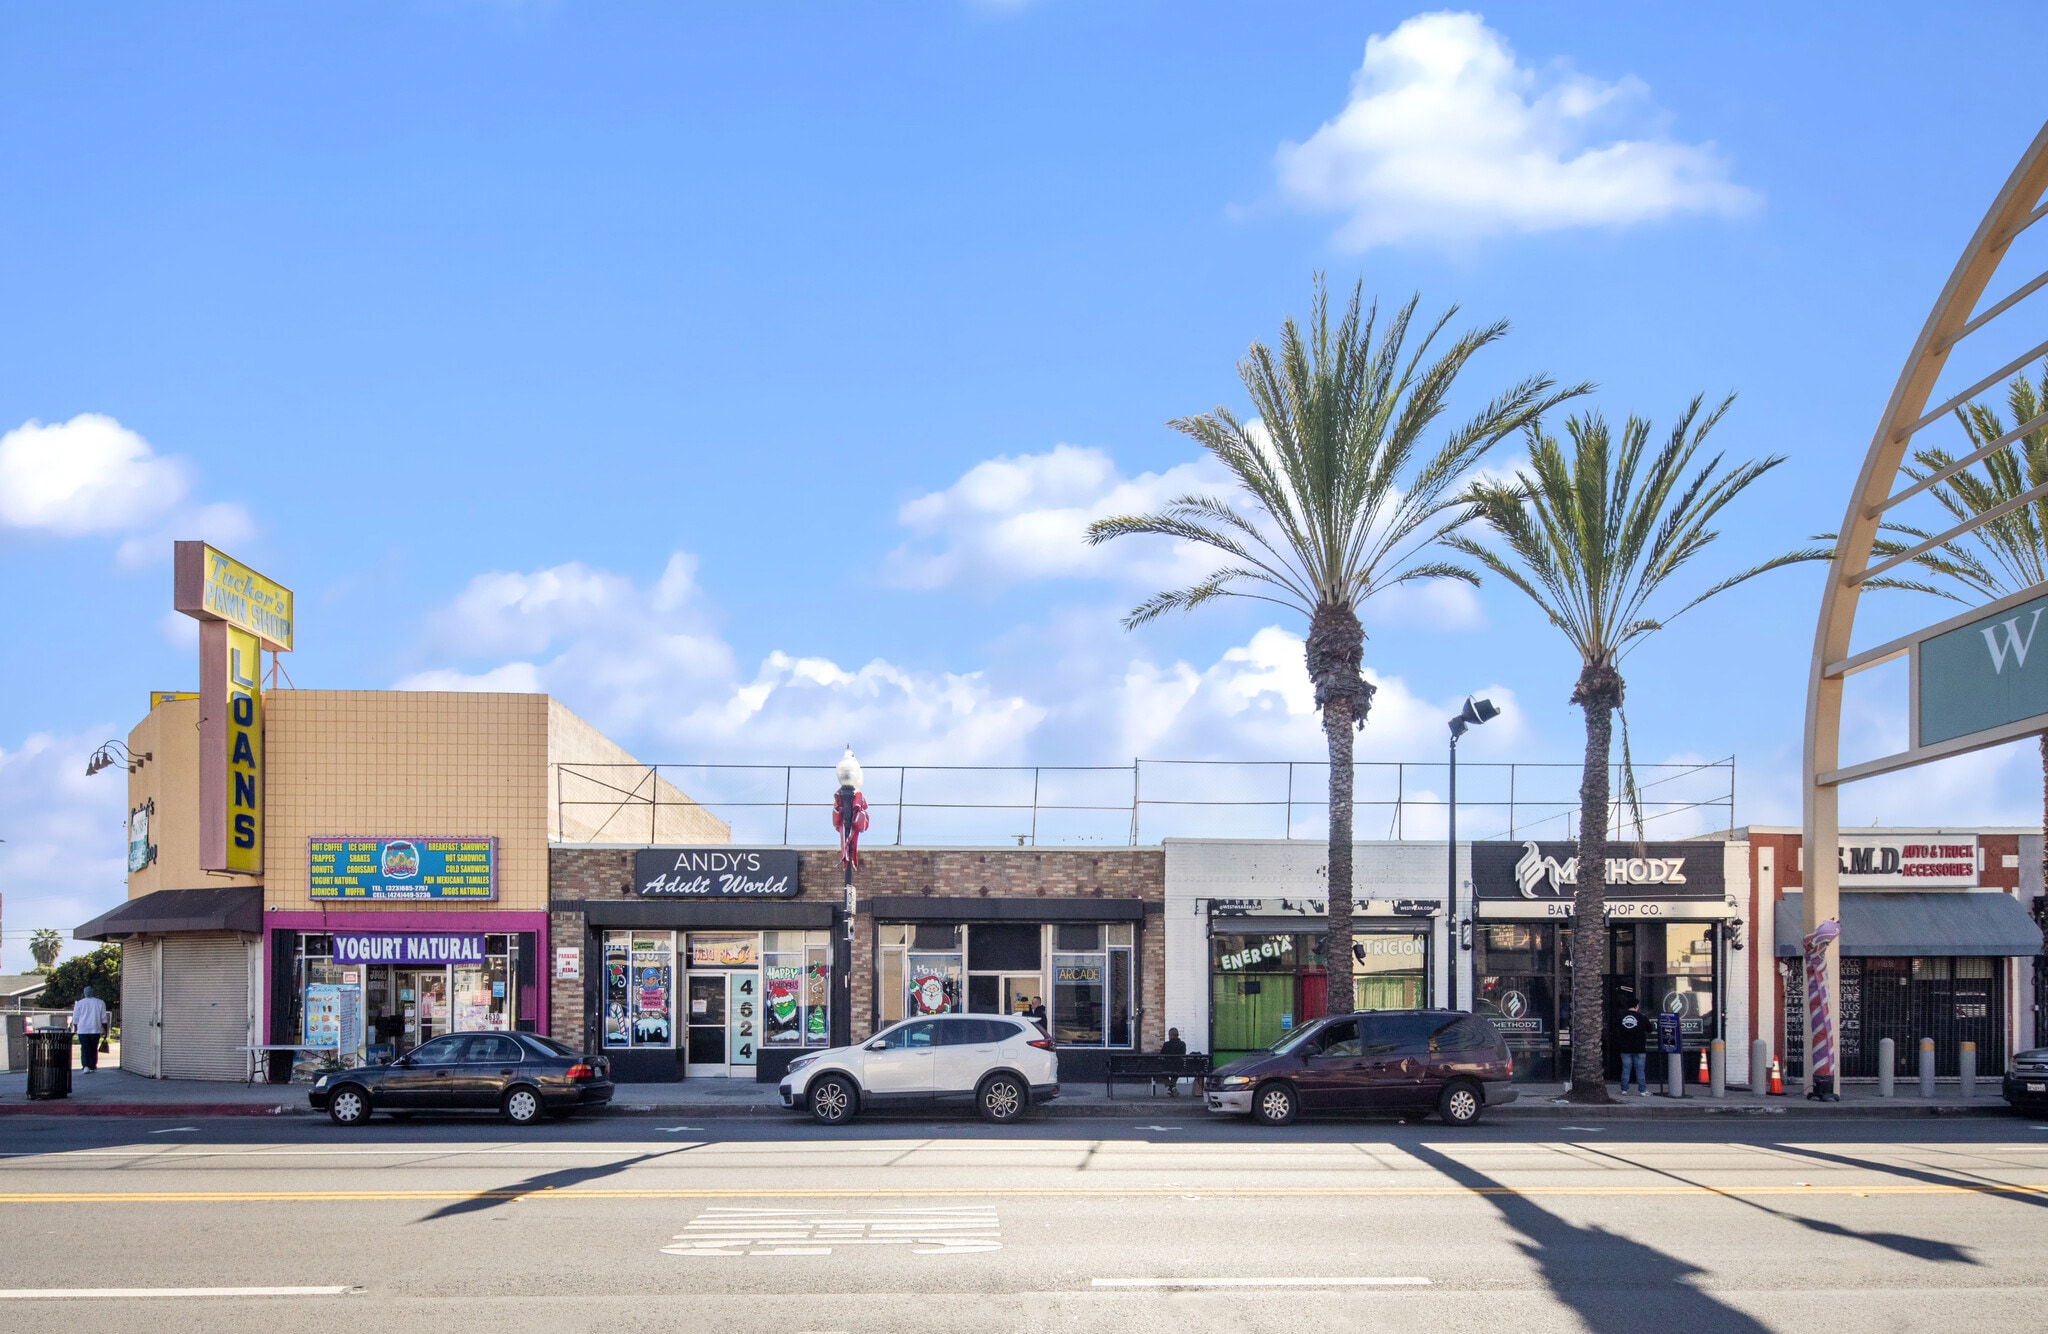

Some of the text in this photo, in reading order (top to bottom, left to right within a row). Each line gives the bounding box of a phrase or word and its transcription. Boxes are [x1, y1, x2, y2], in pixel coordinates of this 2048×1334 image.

[211, 554, 285, 614] Tucker's
[204, 578, 291, 643] PAWN SHOP
[231, 647, 256, 850] LOANS
[311, 843, 343, 851] HOT COFFEE
[348, 843, 357, 851] ICE
[358, 843, 377, 851] COFFEE
[460, 843, 489, 851] SANDWICH
[1901, 845, 1974, 859] AUTO & TRUCK
[311, 854, 335, 862] FRAPPES
[349, 854, 370, 862] SHAKES
[445, 854, 456, 862] HOT
[674, 853, 760, 871] ANDY'S
[311, 865, 334, 874] DONUTS
[346, 865, 377, 874] CROISSANT
[445, 865, 489, 873] COLD SANDWICH
[1902, 863, 1973, 877] ACCESSORIES
[423, 876, 435, 884] PAN
[466, 876, 489, 884] TAMALES
[1548, 856, 1687, 895] MHODZ
[311, 876, 358, 885] YOGURT NATURAL
[642, 873, 788, 895] Adult World
[311, 887, 338, 896] BIONICOS
[345, 887, 365, 896] MUFFIN
[442, 887, 489, 895] JUGOS NATURALES
[1640, 905, 1662, 915] CO.
[336, 937, 482, 960] YOGURT NATURAL
[1362, 939, 1425, 956] TRICION
[1221, 939, 1293, 970] ENERGIA
[766, 966, 799, 980] HAPPY
[916, 964, 930, 975] Ho
[1058, 968, 1099, 980] ARCADE
[768, 981, 799, 990] HOLIDAYS
[484, 1013, 501, 1022] 4630
